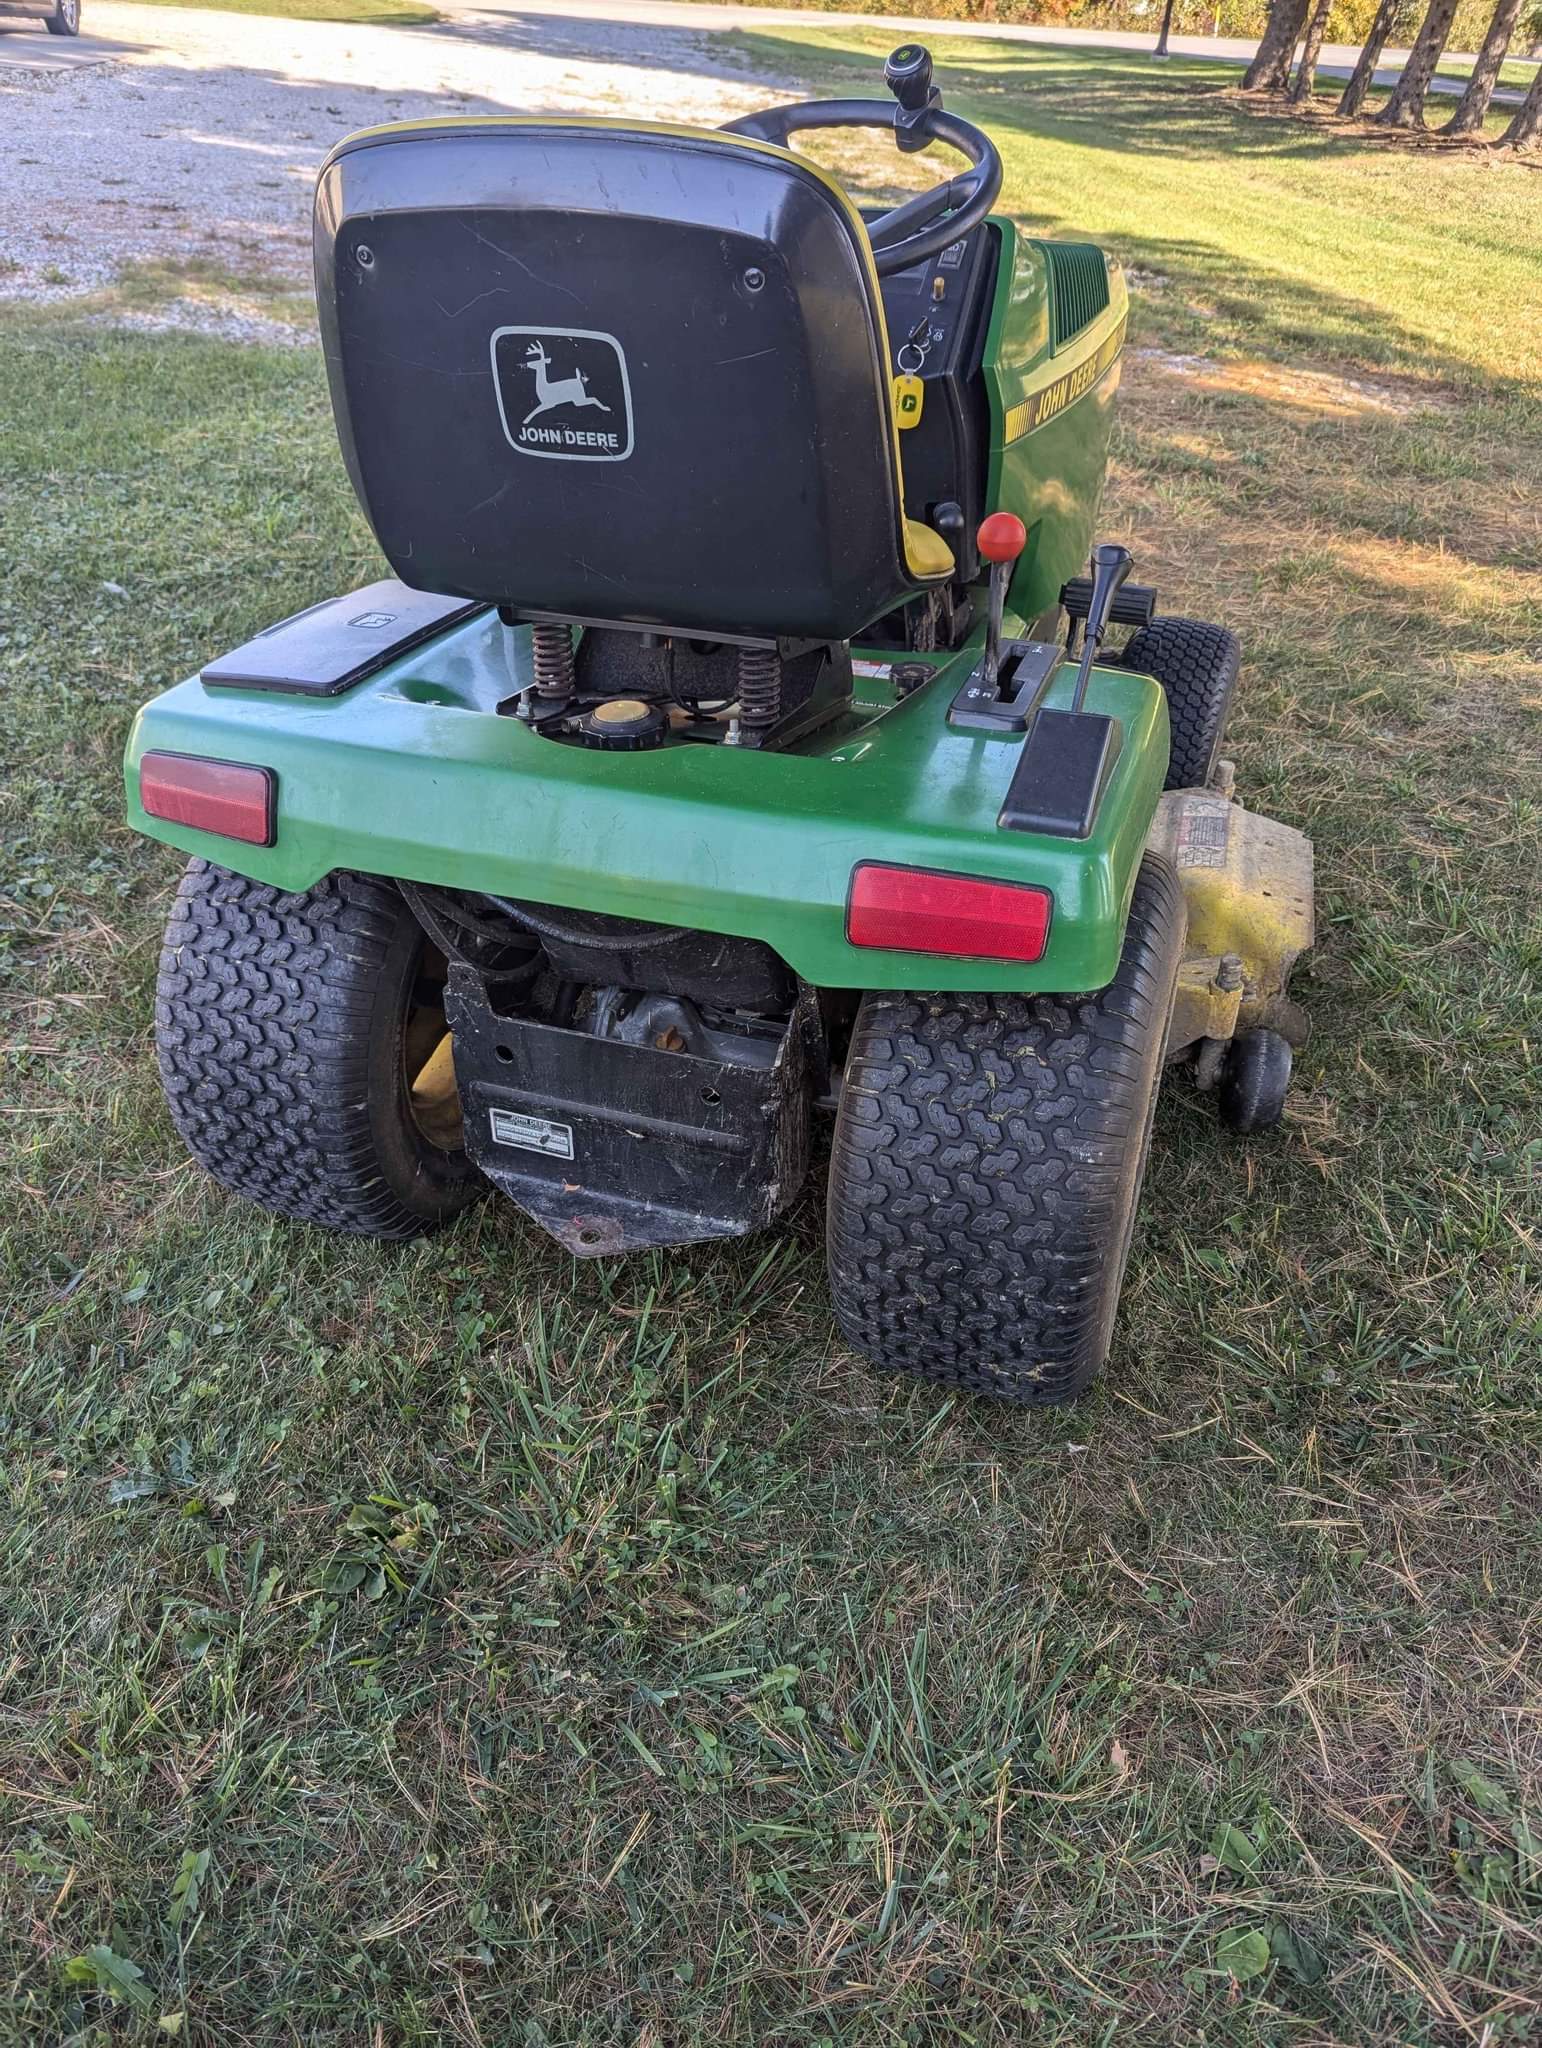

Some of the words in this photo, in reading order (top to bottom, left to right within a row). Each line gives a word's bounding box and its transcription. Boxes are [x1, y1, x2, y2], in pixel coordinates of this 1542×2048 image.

[1035, 377, 1068, 425] JOHN
[1069, 353, 1098, 401] DEERE
[518, 427, 562, 444] JOHN
[564, 430, 619, 448] DEERE
